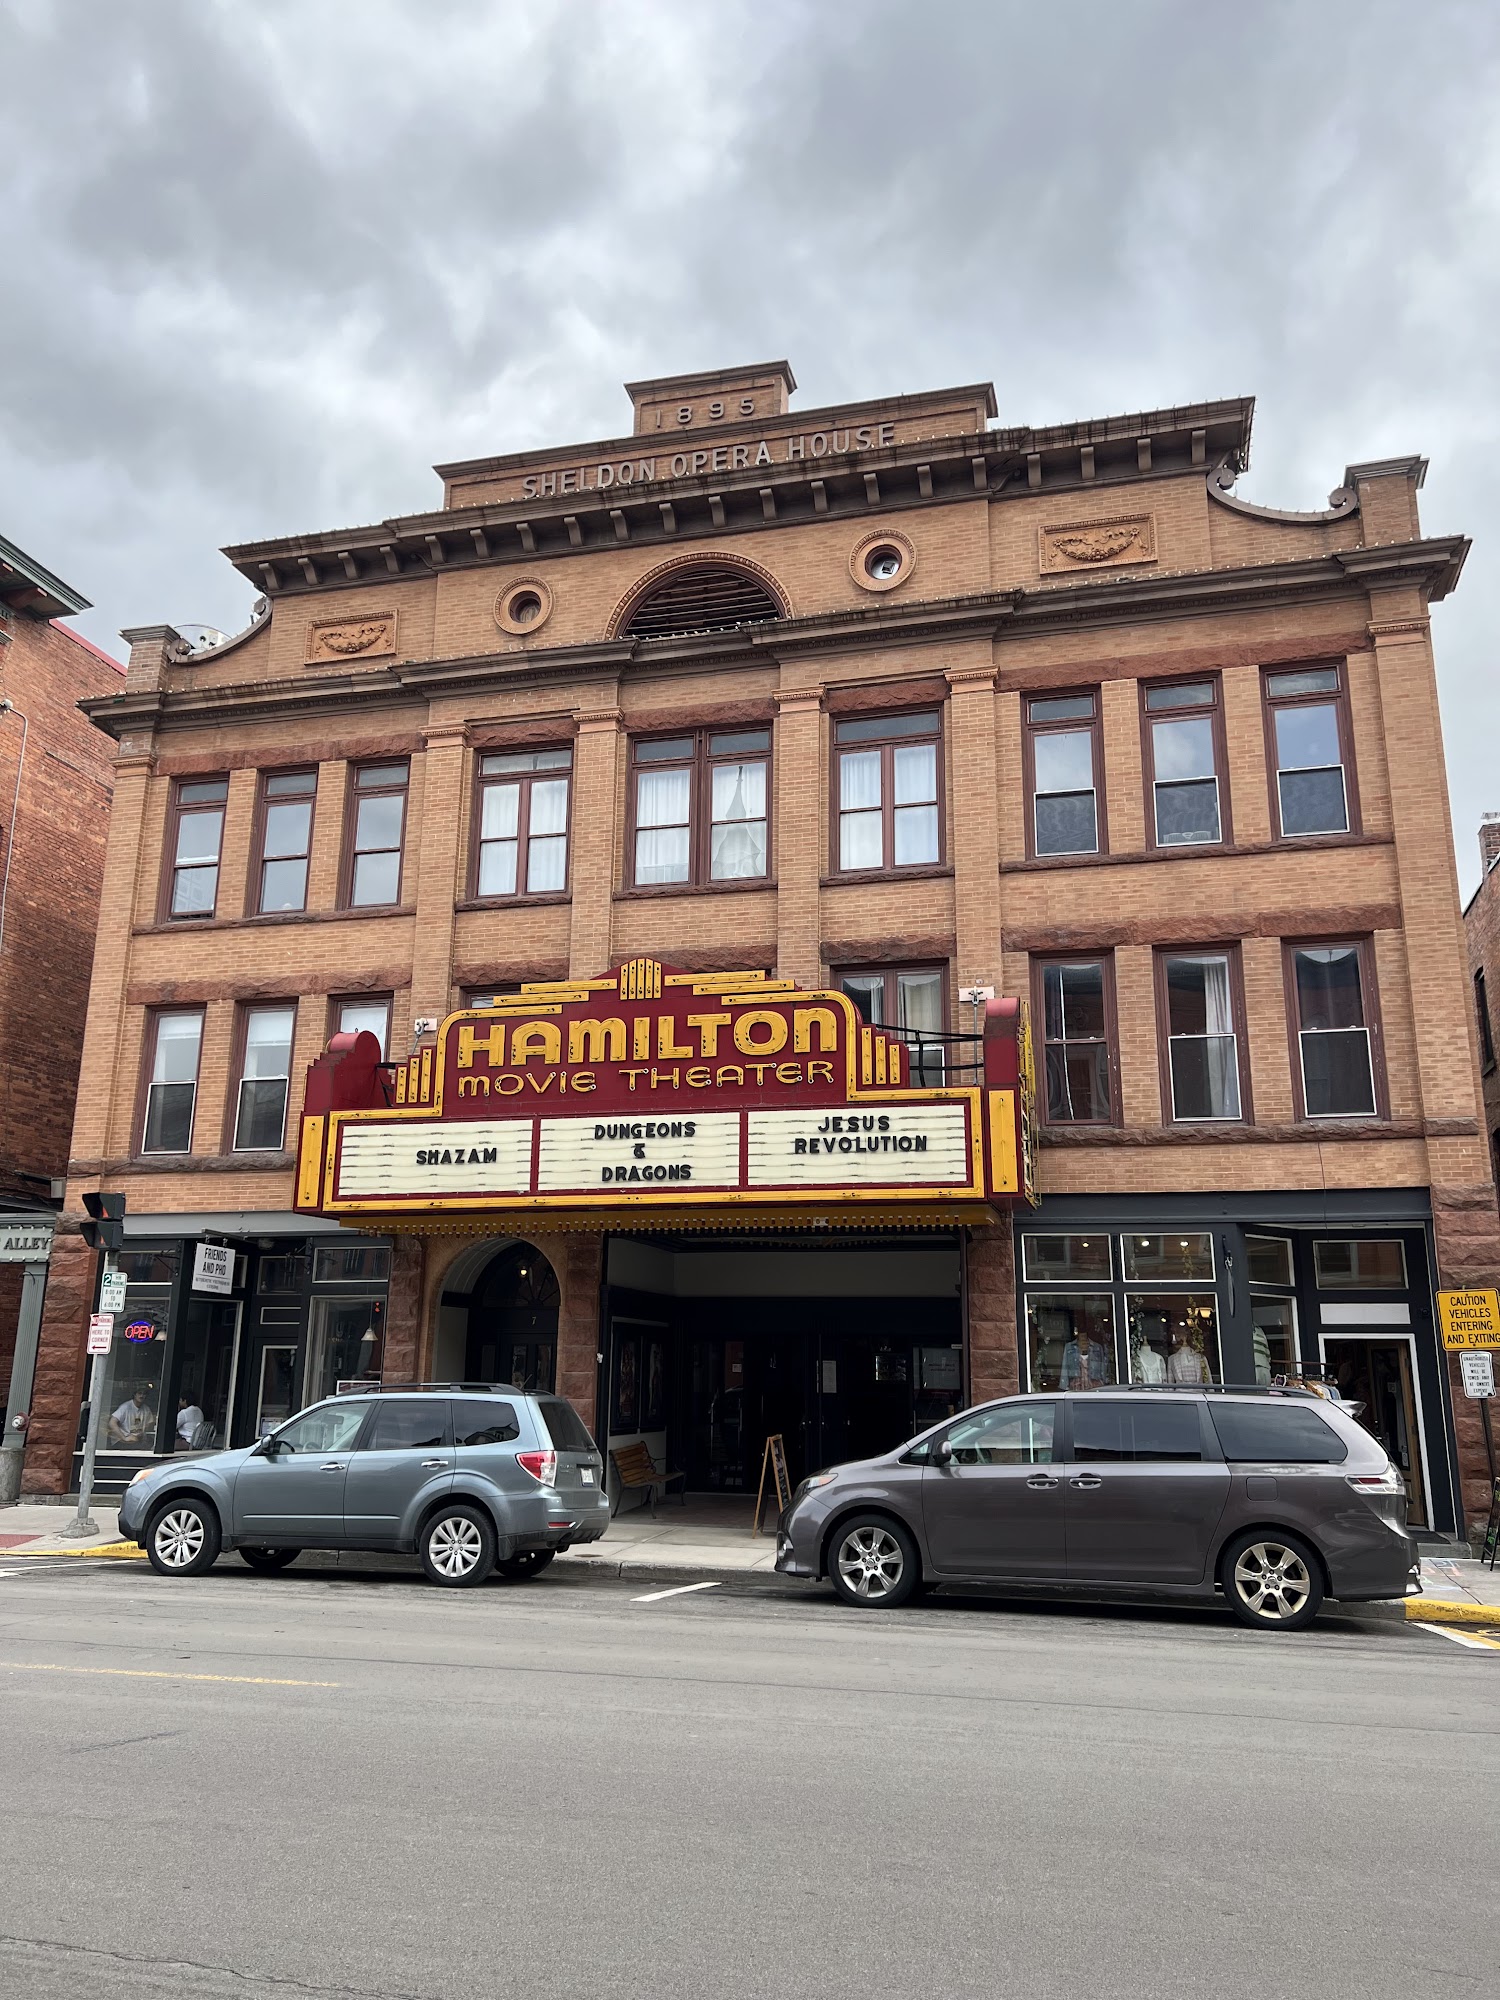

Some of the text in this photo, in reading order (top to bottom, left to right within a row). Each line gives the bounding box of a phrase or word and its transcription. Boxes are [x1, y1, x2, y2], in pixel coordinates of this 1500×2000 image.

[656, 398, 755, 428] 1895
[522, 423, 895, 499] SHELDON OPERA HOUSE
[457, 1007, 838, 1069] HAMILTON
[458, 1060, 834, 1097] MOVIE THEATER
[594, 1121, 696, 1140] DUNGEONS
[818, 1115, 890, 1132] JESUS
[633, 1143, 646, 1159] &
[794, 1135, 928, 1154] REVOLUTION
[416, 1147, 497, 1165] SHAZAM
[602, 1165, 692, 1182] DRAGONS
[3, 1237, 50, 1250] ALLEY
[204, 1247, 228, 1262] FRIENDS
[202, 1261, 227, 1276] AND PHO
[104, 1274, 112, 1286] 2
[1450, 1295, 1487, 1307] CAUTION
[1449, 1308, 1492, 1319] VEHICLES
[125, 1325, 154, 1338] OPEN
[1450, 1320, 1493, 1331] ENTERING
[1447, 1333, 1500, 1344] AND EXITING
